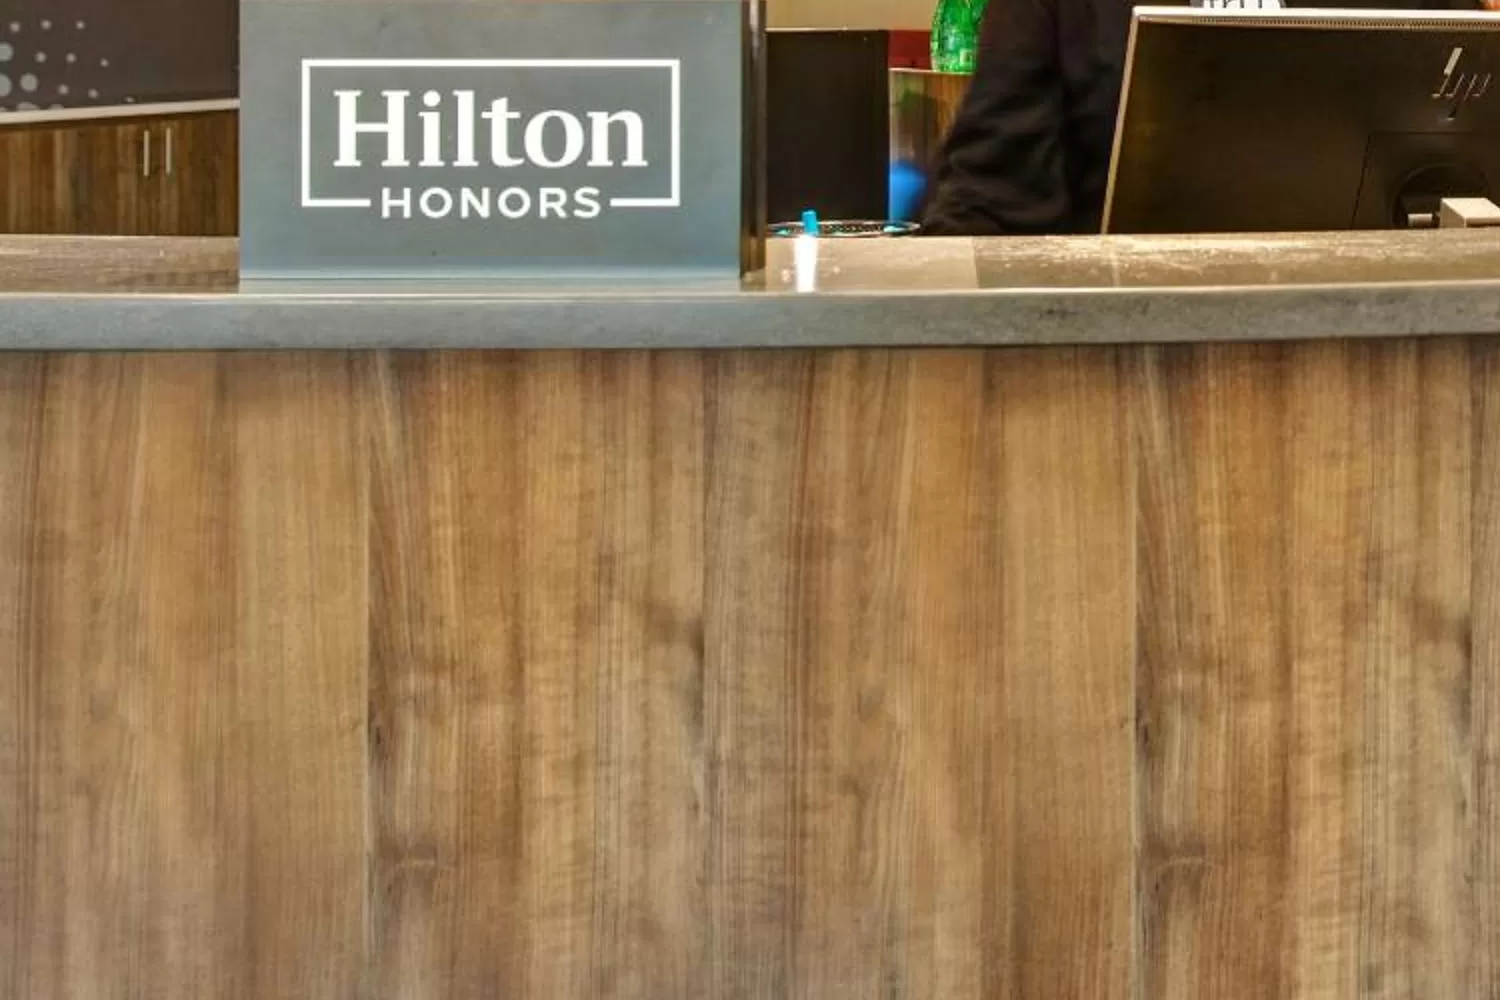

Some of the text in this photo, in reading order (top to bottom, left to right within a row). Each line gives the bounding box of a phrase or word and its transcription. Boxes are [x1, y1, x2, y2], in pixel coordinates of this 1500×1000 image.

[1431, 47, 1491, 120] hp
[332, 90, 648, 168] Hilton
[381, 186, 601, 219] HONORS
